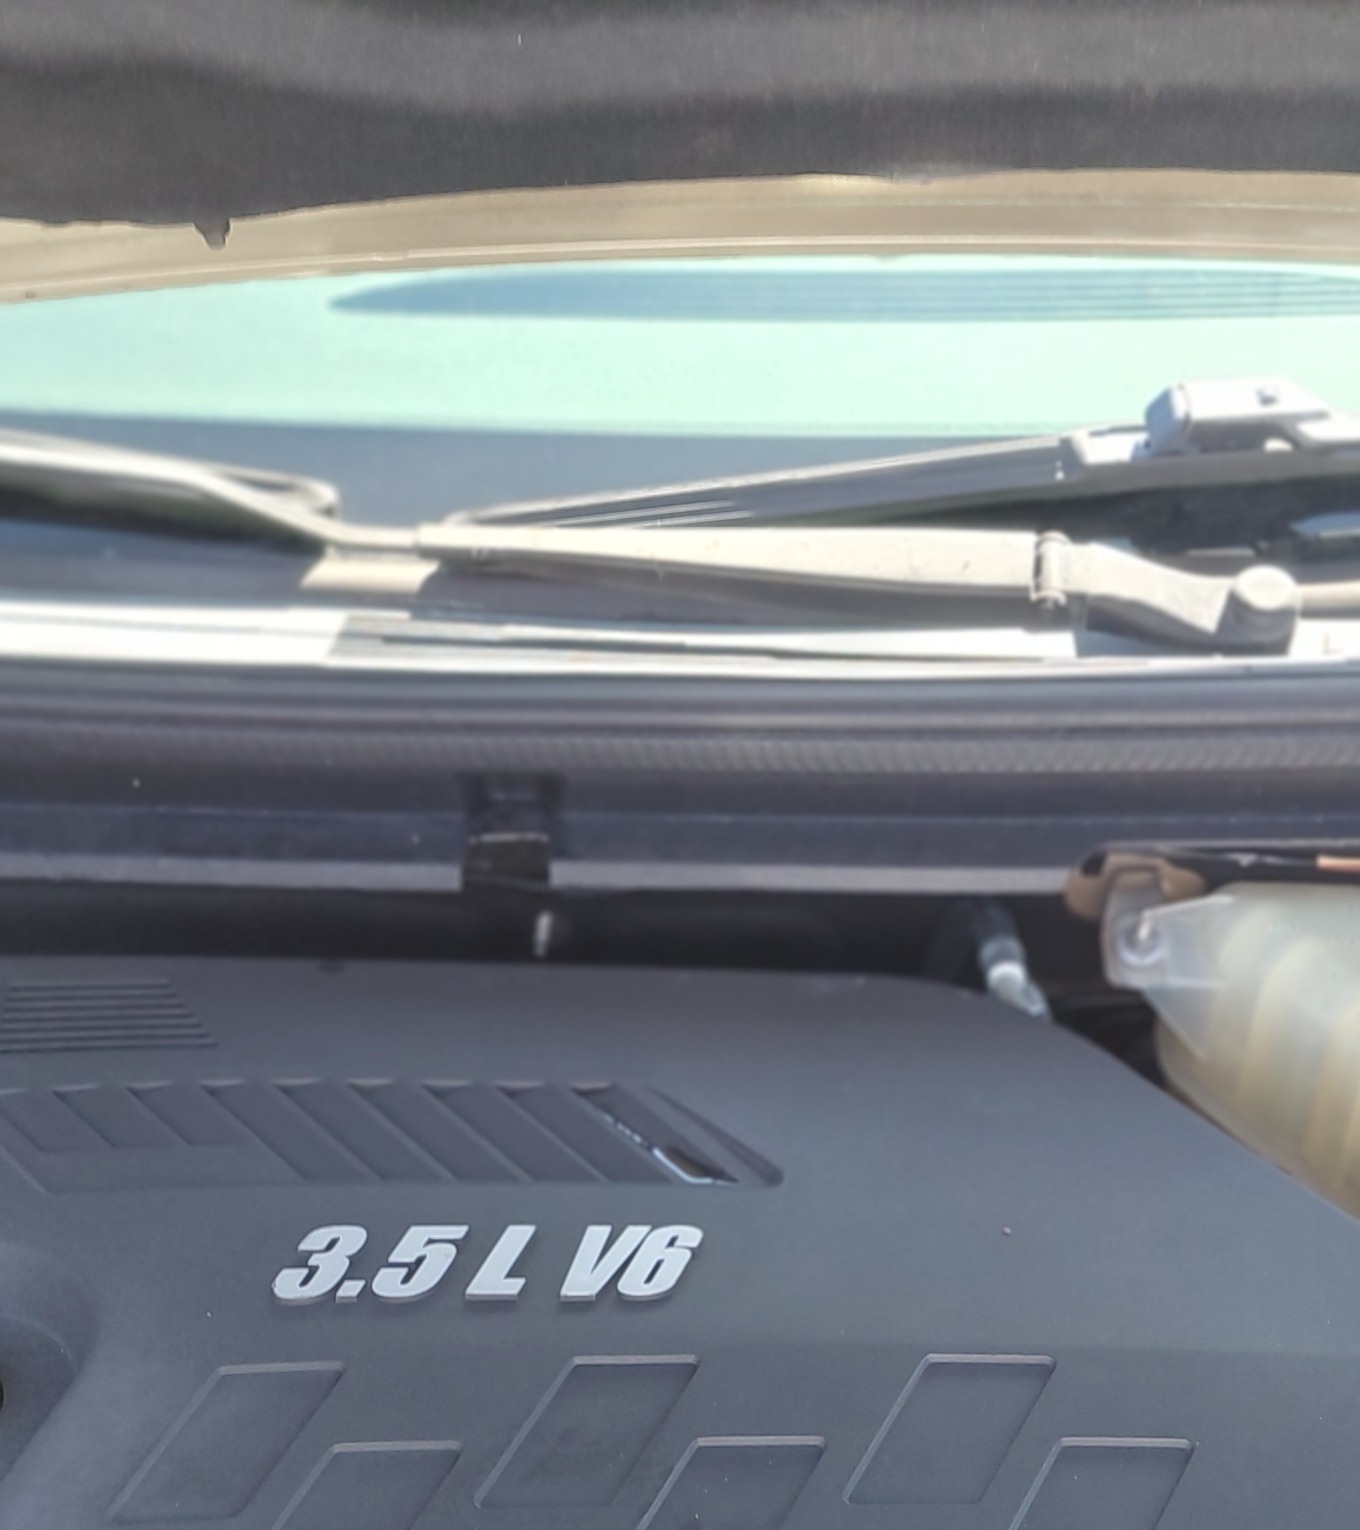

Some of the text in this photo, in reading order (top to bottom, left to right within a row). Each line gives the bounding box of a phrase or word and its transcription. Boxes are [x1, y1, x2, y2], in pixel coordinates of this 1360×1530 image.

[270, 1223, 705, 1304] 3.5 L V6
